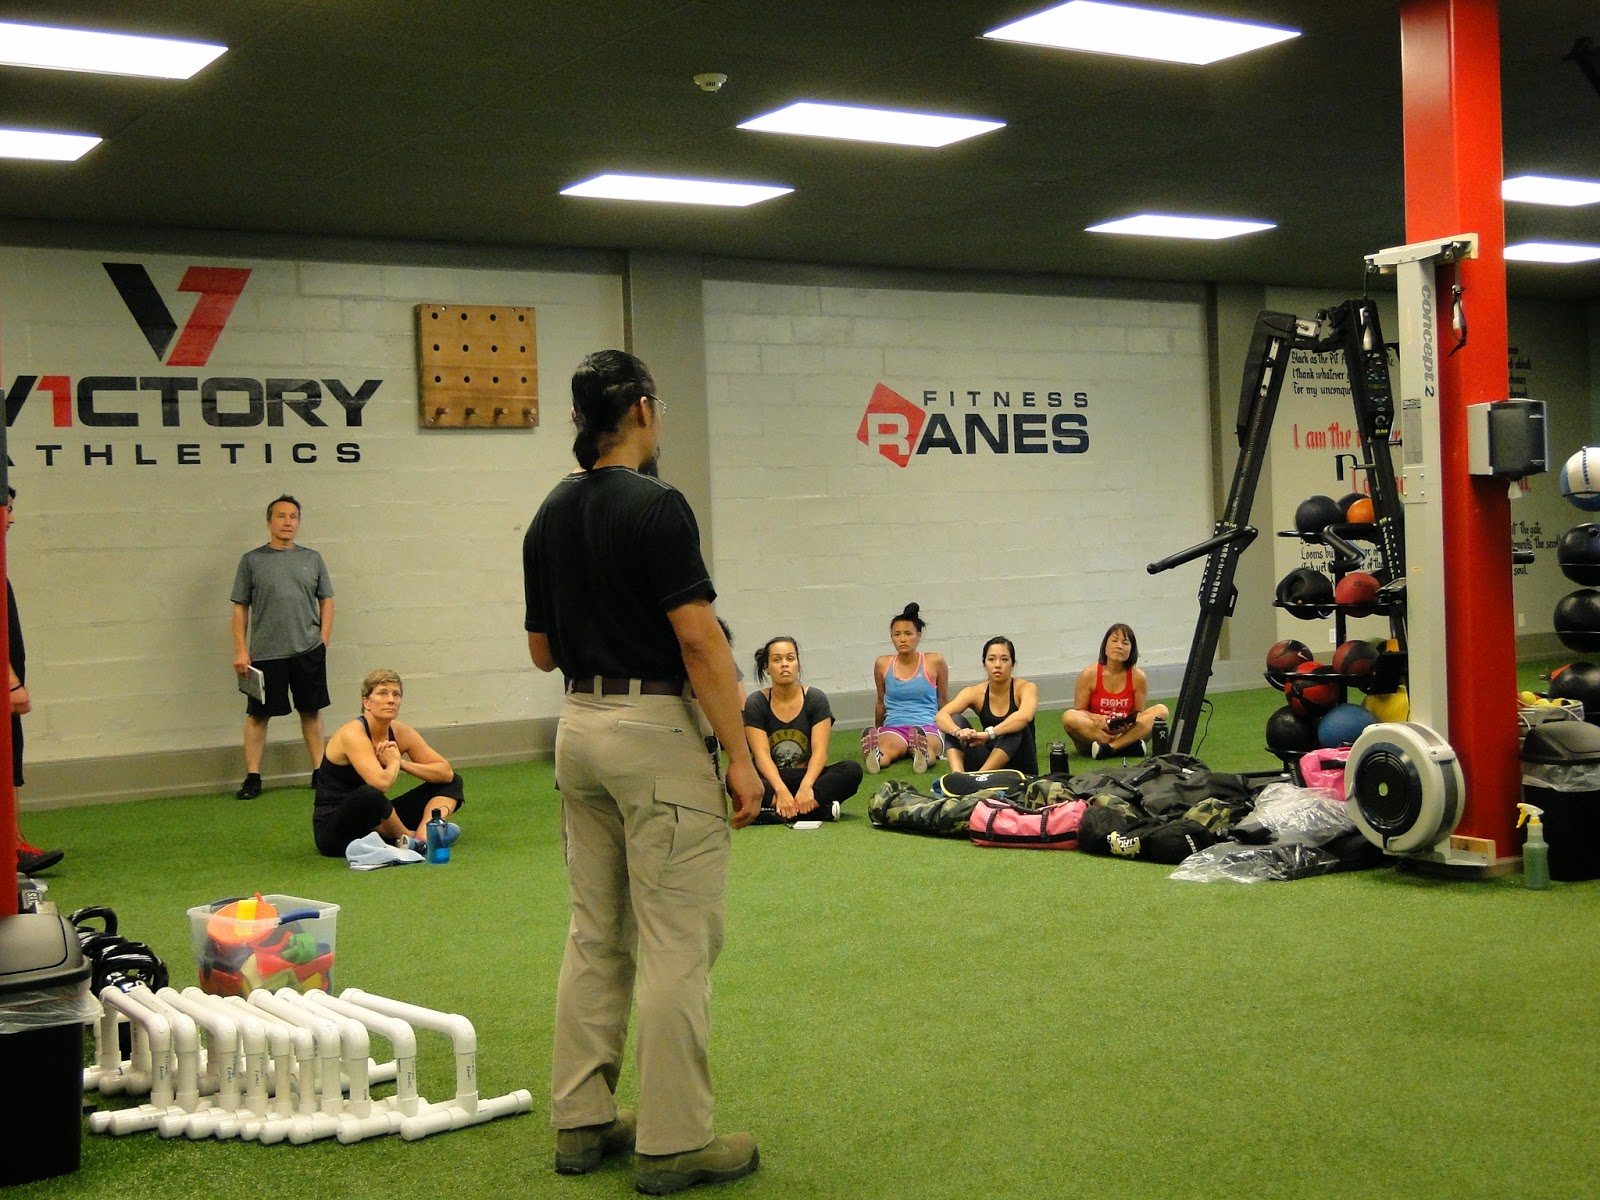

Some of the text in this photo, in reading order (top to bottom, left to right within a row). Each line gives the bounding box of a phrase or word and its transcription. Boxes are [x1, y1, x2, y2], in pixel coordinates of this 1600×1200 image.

[1421, 284, 1435, 398] concept 2
[1315, 367, 1345, 380] whatever
[923, 390, 1088, 408] FITNESS
[867, 412, 1090, 455] RANES
[1306, 430, 1327, 449] am
[1328, 422, 1352, 449] the
[1301, 547, 1323, 560] Looms
[1100, 698, 1129, 707] FIGHT
